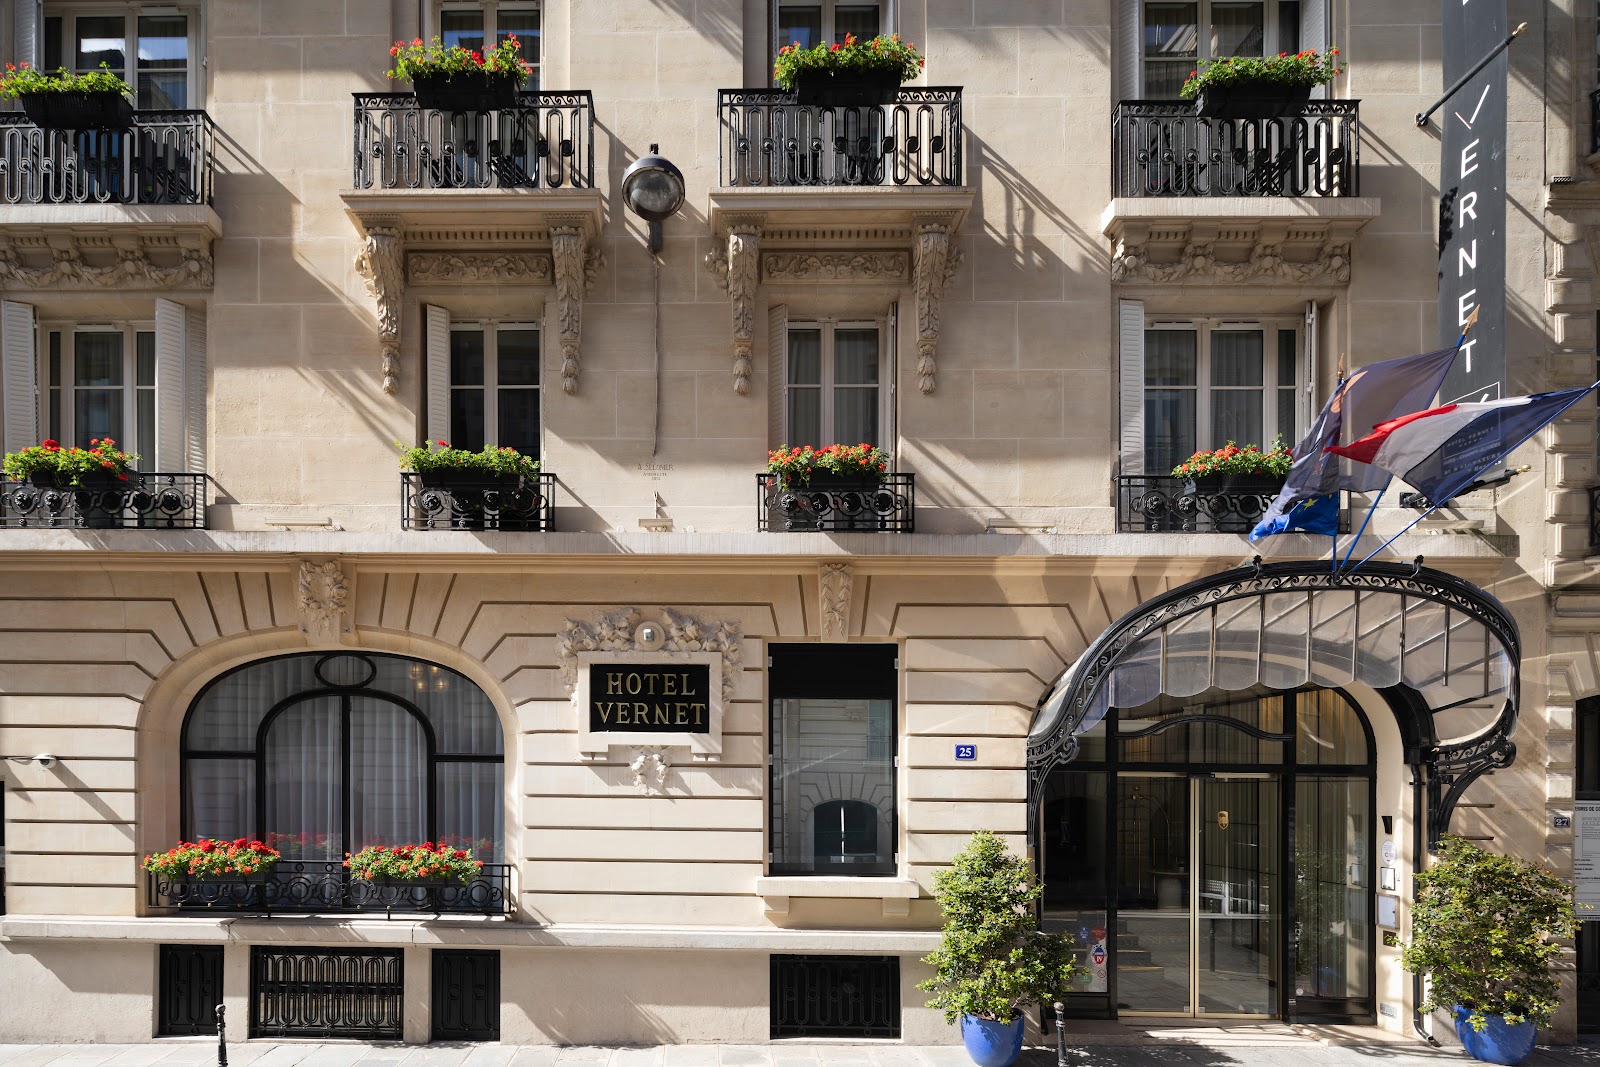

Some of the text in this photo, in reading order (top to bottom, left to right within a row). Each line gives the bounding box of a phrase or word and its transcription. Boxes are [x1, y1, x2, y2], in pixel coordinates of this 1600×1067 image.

[1454, 84, 1491, 373] VERNET
[606, 672, 696, 696] HOTEL
[594, 701, 707, 725] VERNET
[959, 747, 972, 757] 25
[1555, 818, 1568, 826] 27
